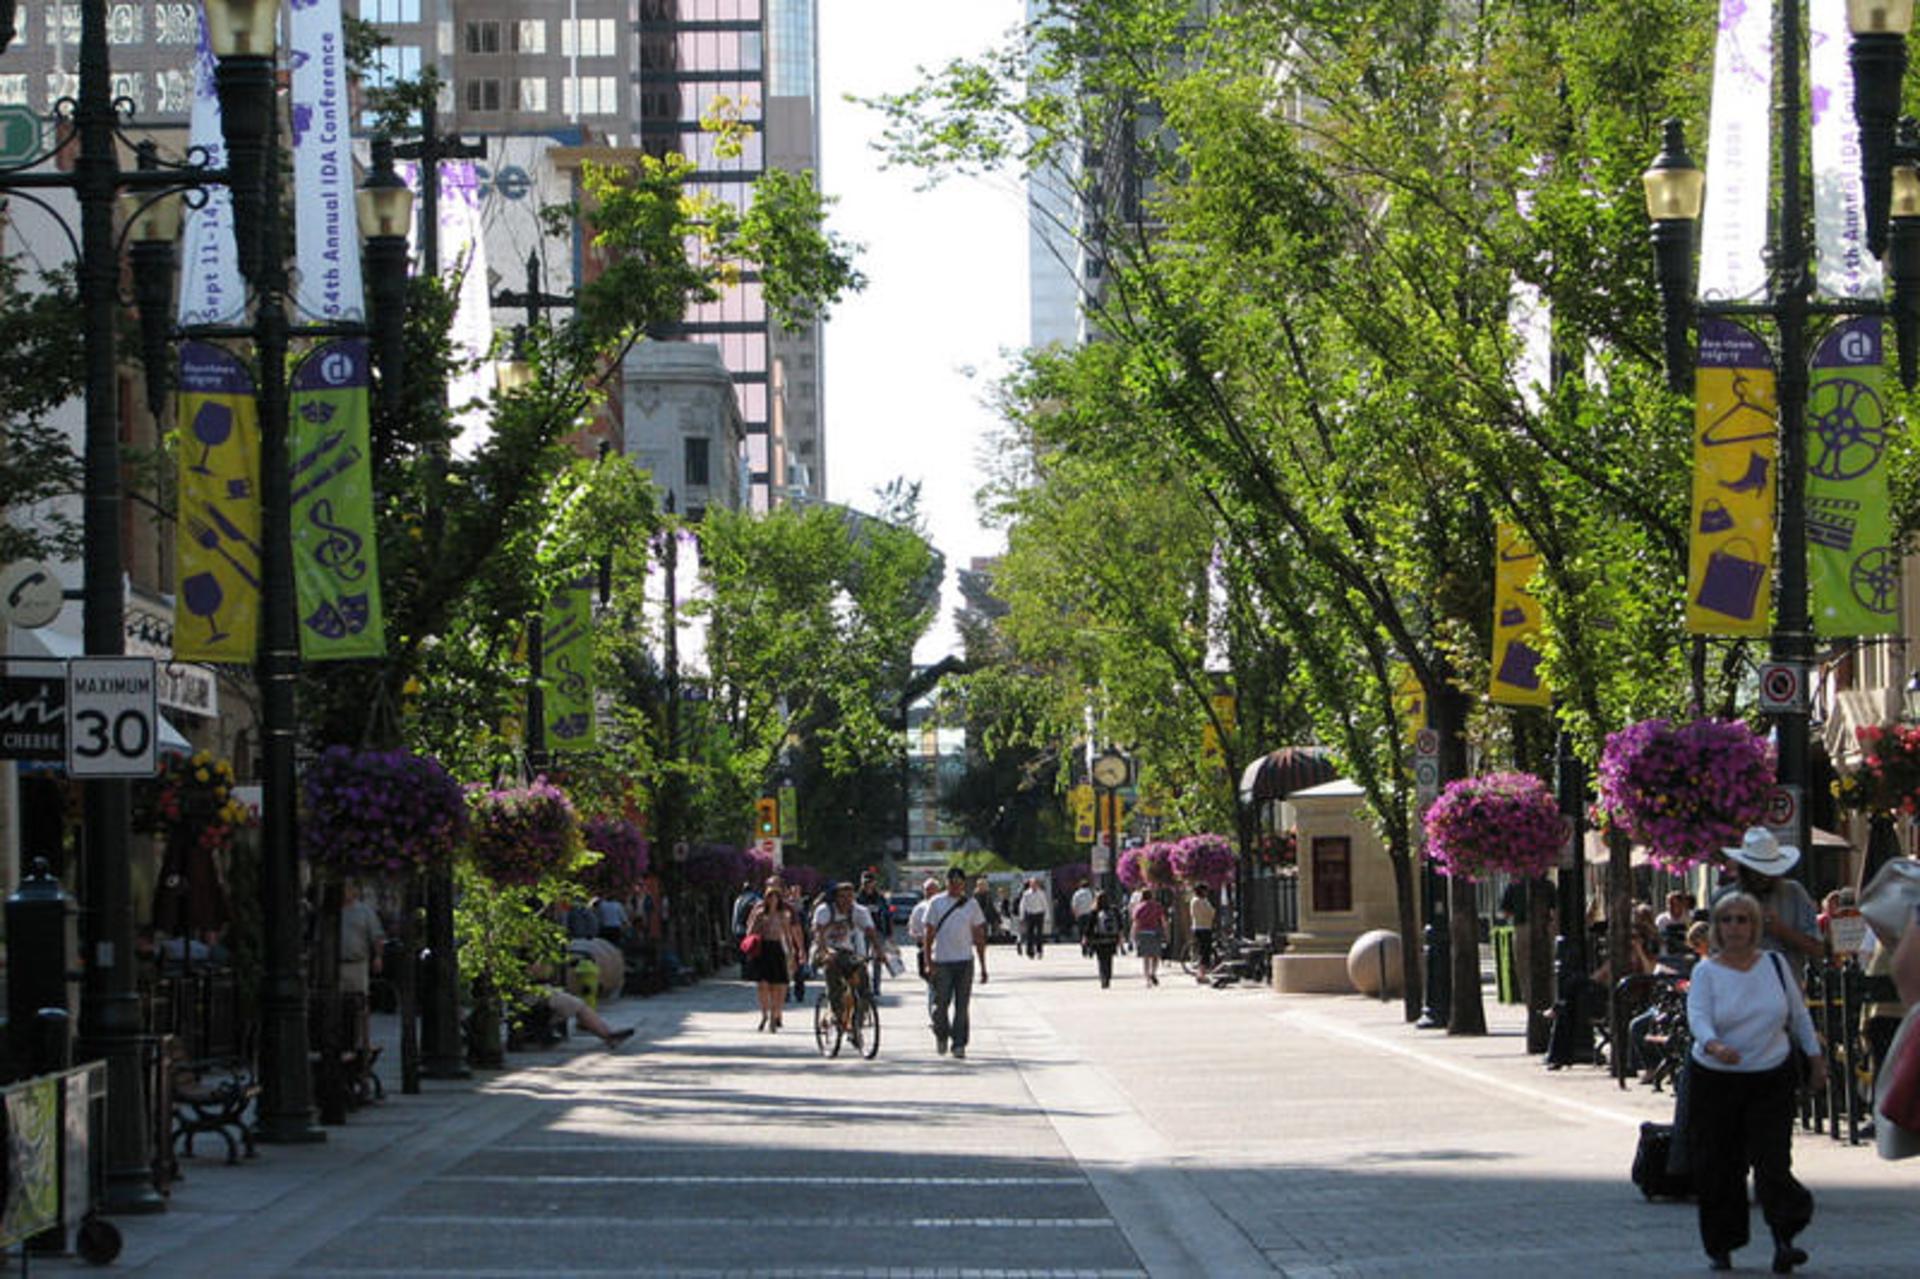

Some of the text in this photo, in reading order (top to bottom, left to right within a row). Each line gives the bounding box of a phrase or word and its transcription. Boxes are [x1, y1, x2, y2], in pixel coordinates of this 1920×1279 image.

[1840, 131, 1858, 165] IDA
[319, 32, 341, 315] 54th Annual IDA Conference
[1842, 171, 1860, 243] Annual
[201, 272, 223, 318] Sept
[74, 676, 150, 694] MAXIMUM
[75, 709, 151, 758] 30
